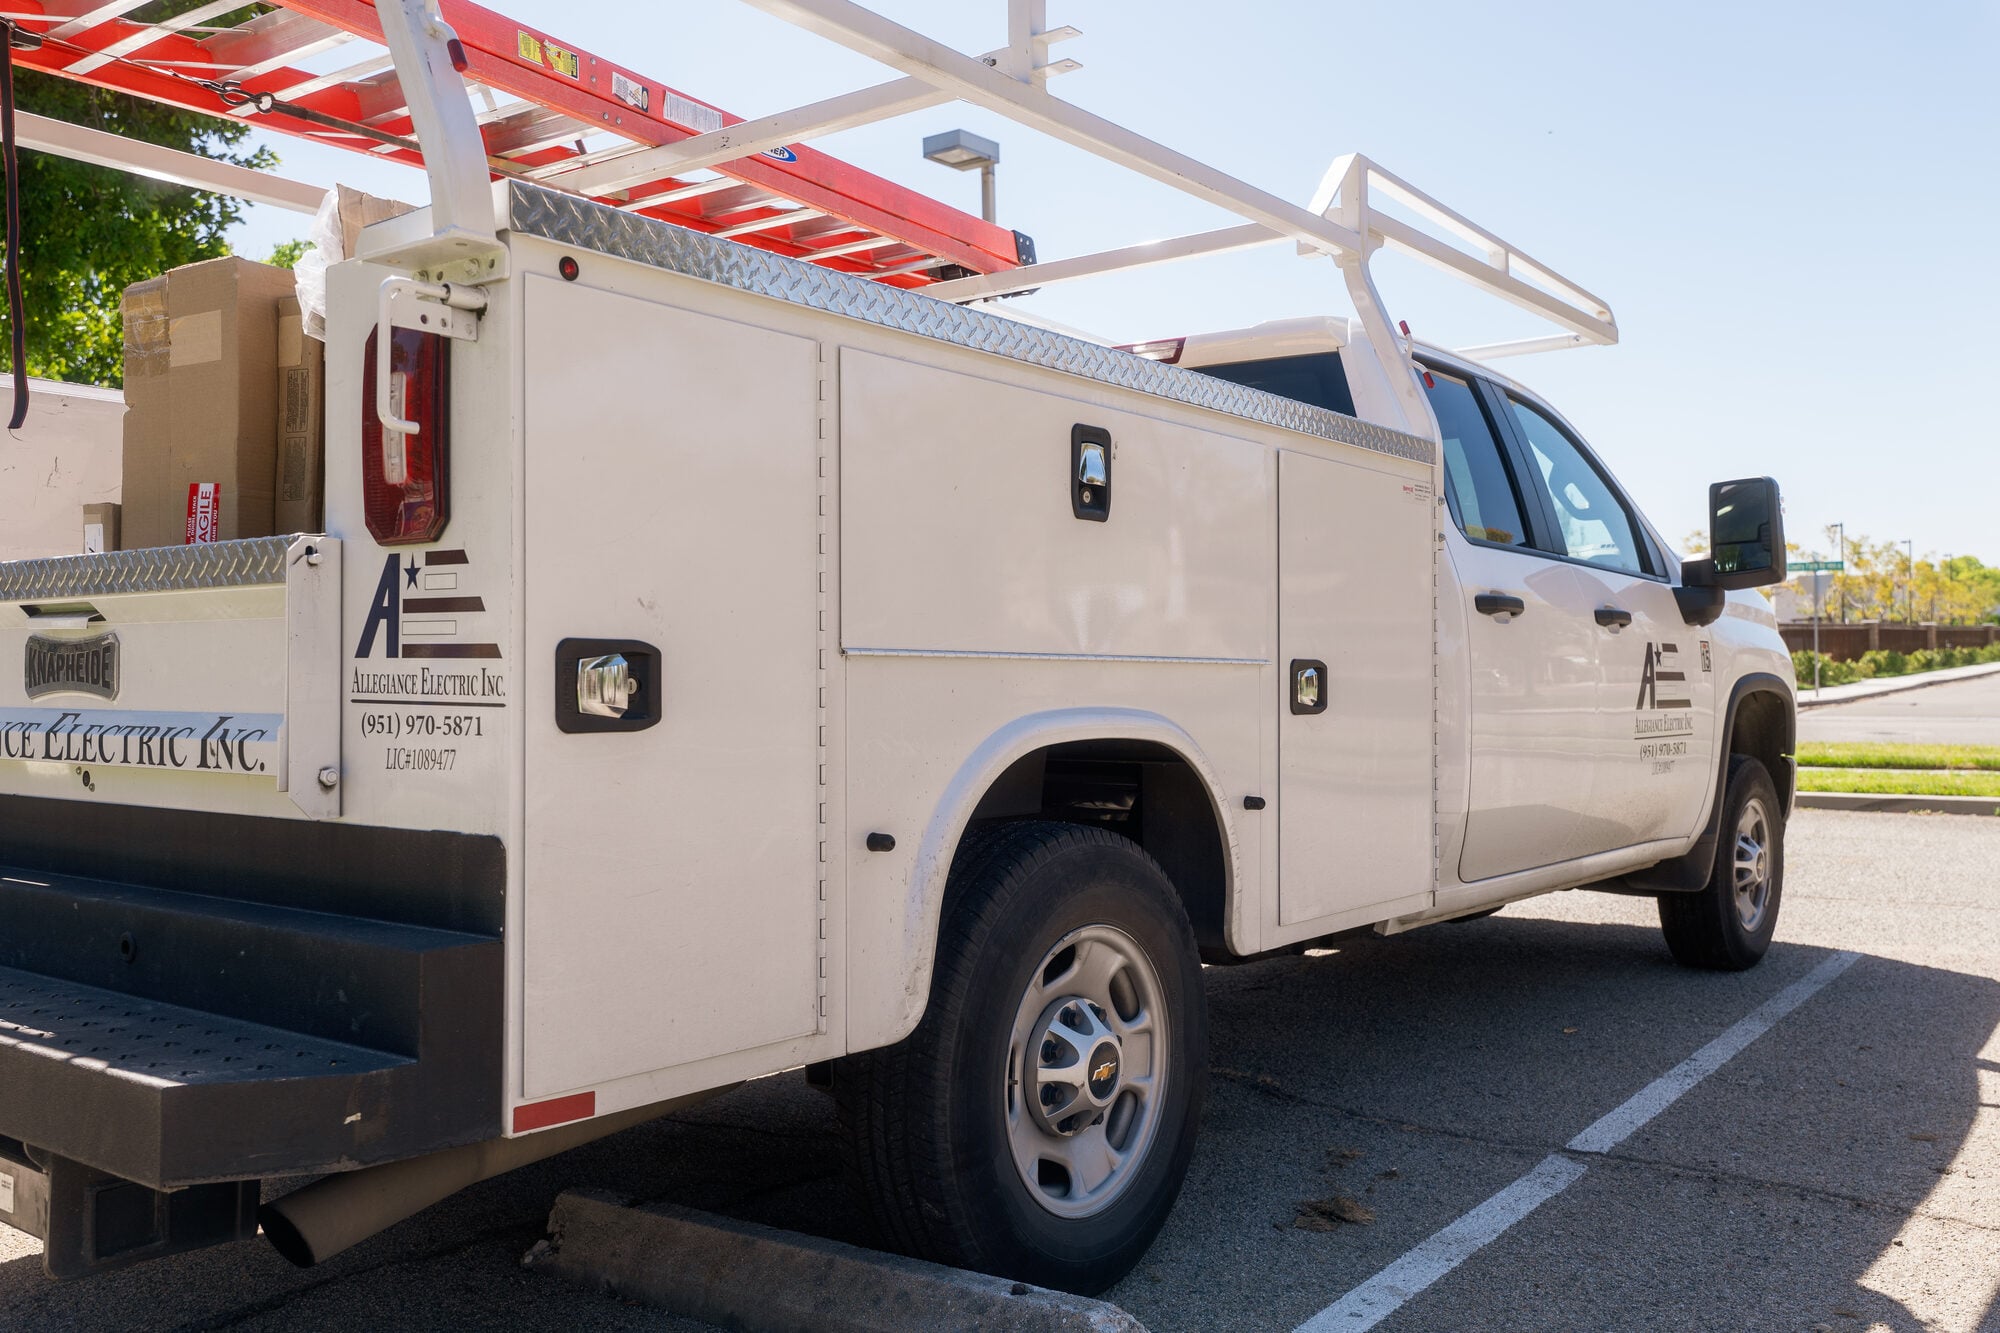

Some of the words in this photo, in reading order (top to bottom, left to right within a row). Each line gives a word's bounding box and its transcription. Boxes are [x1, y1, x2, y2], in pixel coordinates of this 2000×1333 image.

[28, 645, 112, 690] KNAPHEIDE
[352, 666, 418, 695] ALLEGIANCE
[421, 667, 479, 696] ELECTRIC
[481, 668, 506, 697] INC.
[361, 712, 401, 739] (951)
[405, 715, 483, 736] 970-5871
[42, 712, 197, 768] ELECTRIC
[197, 716, 268, 772] INC.
[1640, 743, 1658, 762] (951)
[1658, 741, 1687, 757] 970-5871
[385, 748, 457, 771] LIC#1089477
